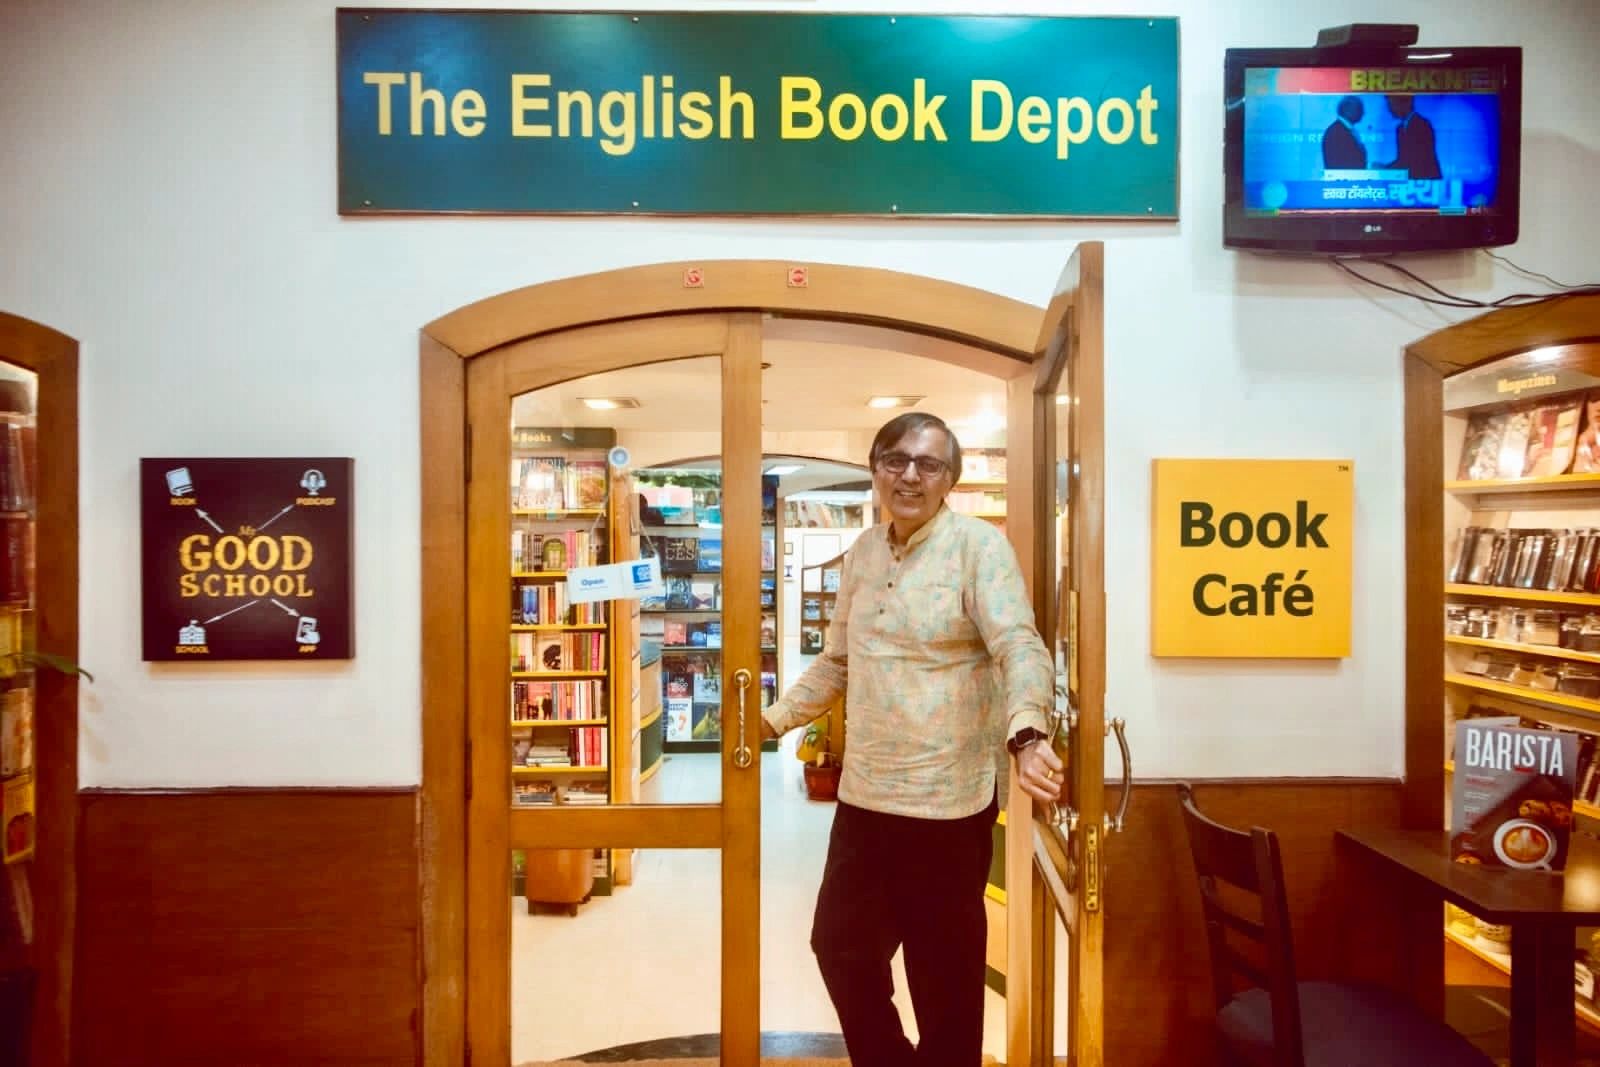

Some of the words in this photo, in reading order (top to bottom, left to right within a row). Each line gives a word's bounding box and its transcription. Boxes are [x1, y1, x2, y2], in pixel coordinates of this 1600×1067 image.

[363, 72, 487, 137] The
[511, 74, 755, 156] English
[780, 76, 948, 141] Book
[970, 79, 1159, 160] Depot
[1180, 500, 1329, 549] Book
[179, 534, 313, 571] GOOD
[179, 573, 313, 598] SCHOOL
[1193, 569, 1314, 617] Café
[1465, 728, 1564, 777] BARISTA
